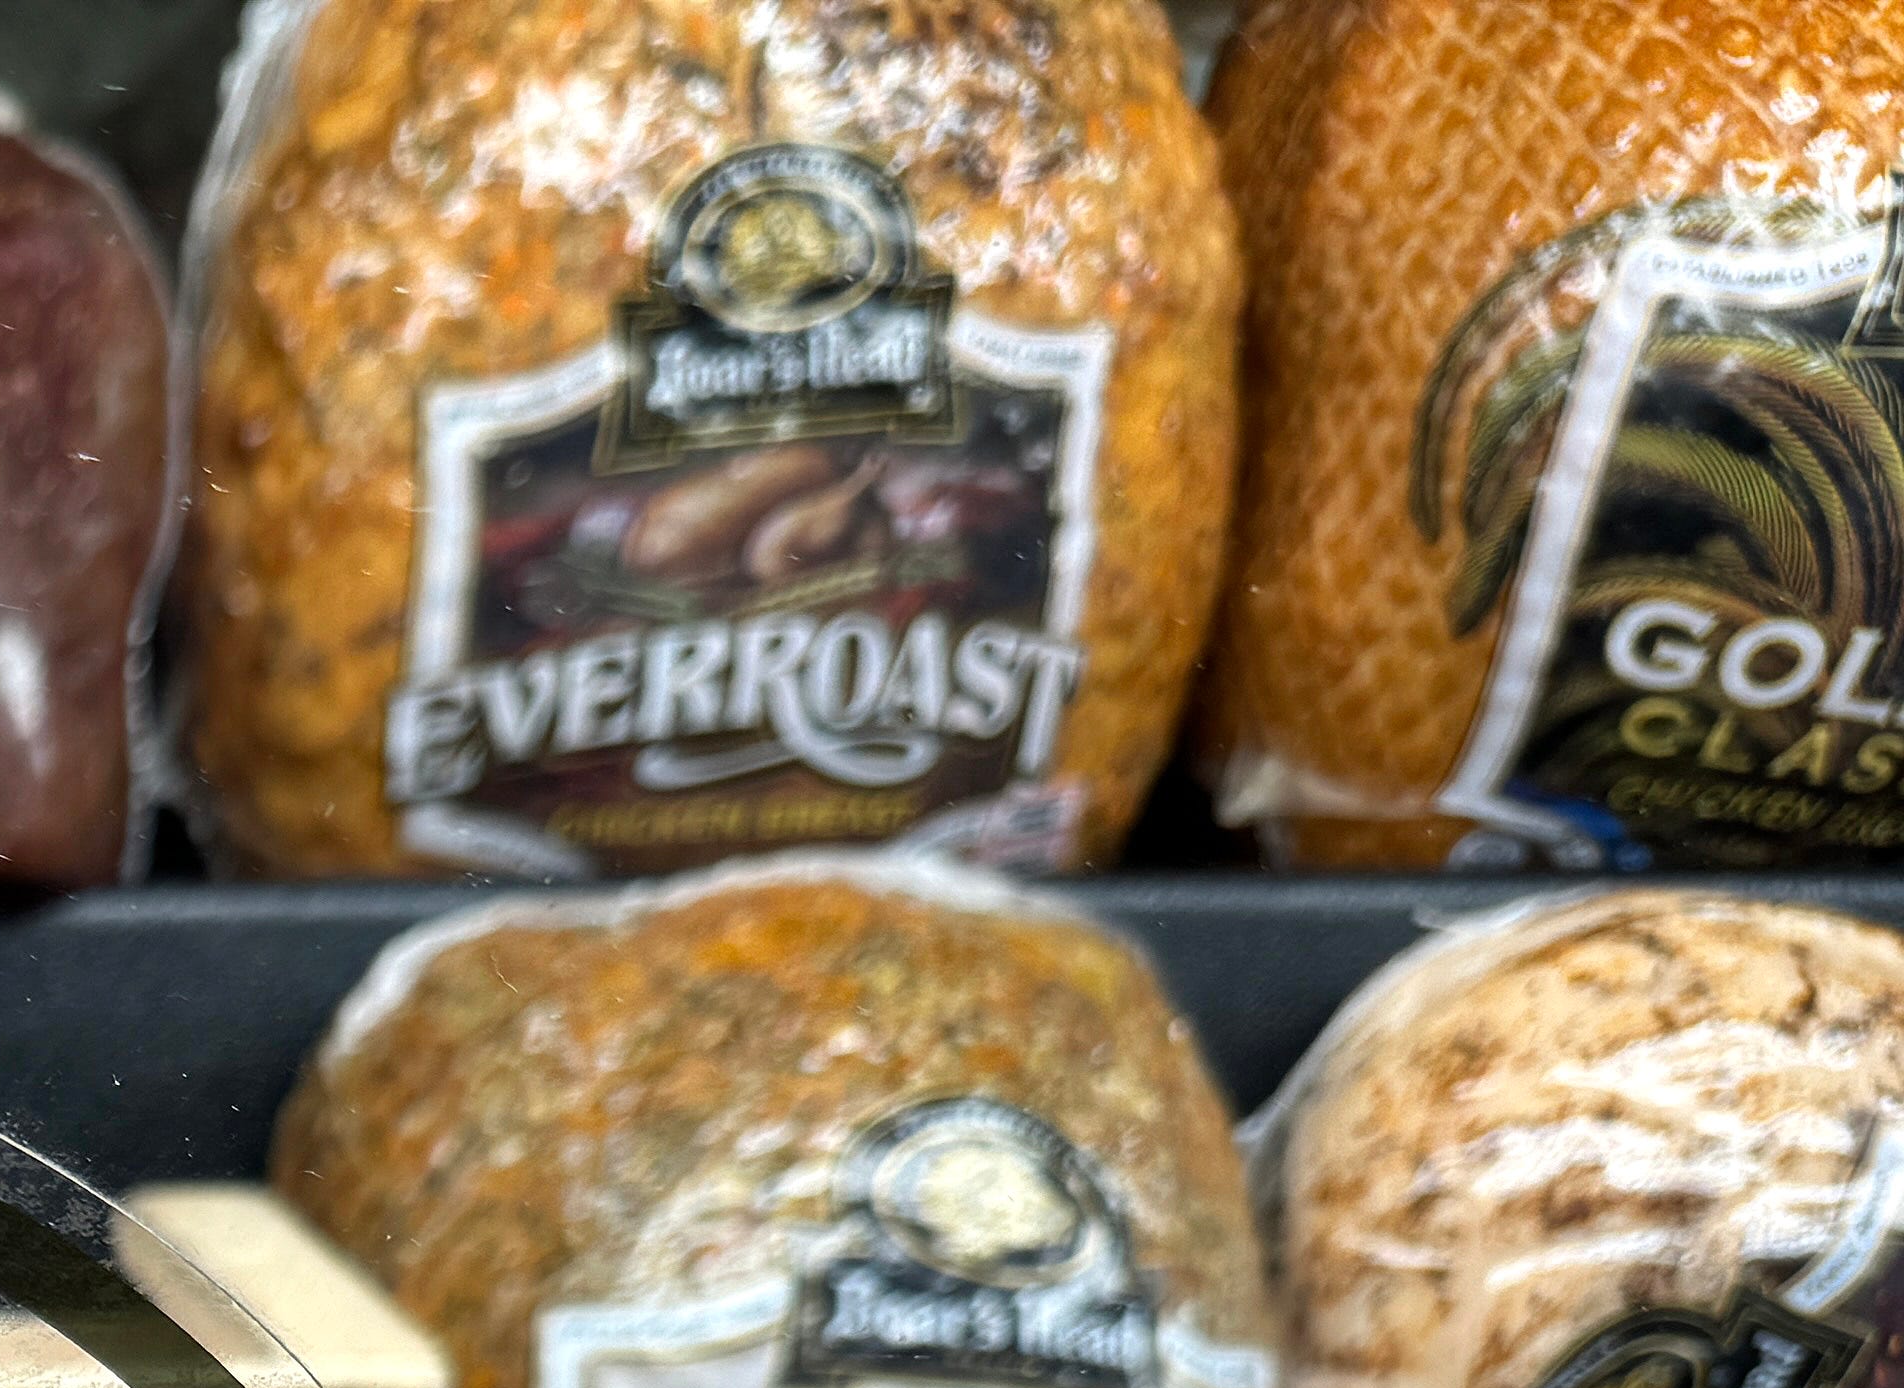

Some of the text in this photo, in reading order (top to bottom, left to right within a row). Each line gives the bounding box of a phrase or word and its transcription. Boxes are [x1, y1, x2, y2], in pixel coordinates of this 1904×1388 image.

[388, 610, 1083, 800] EVERROAST
[1602, 598, 1904, 728] GOL
[1618, 697, 1904, 796] CLAS
